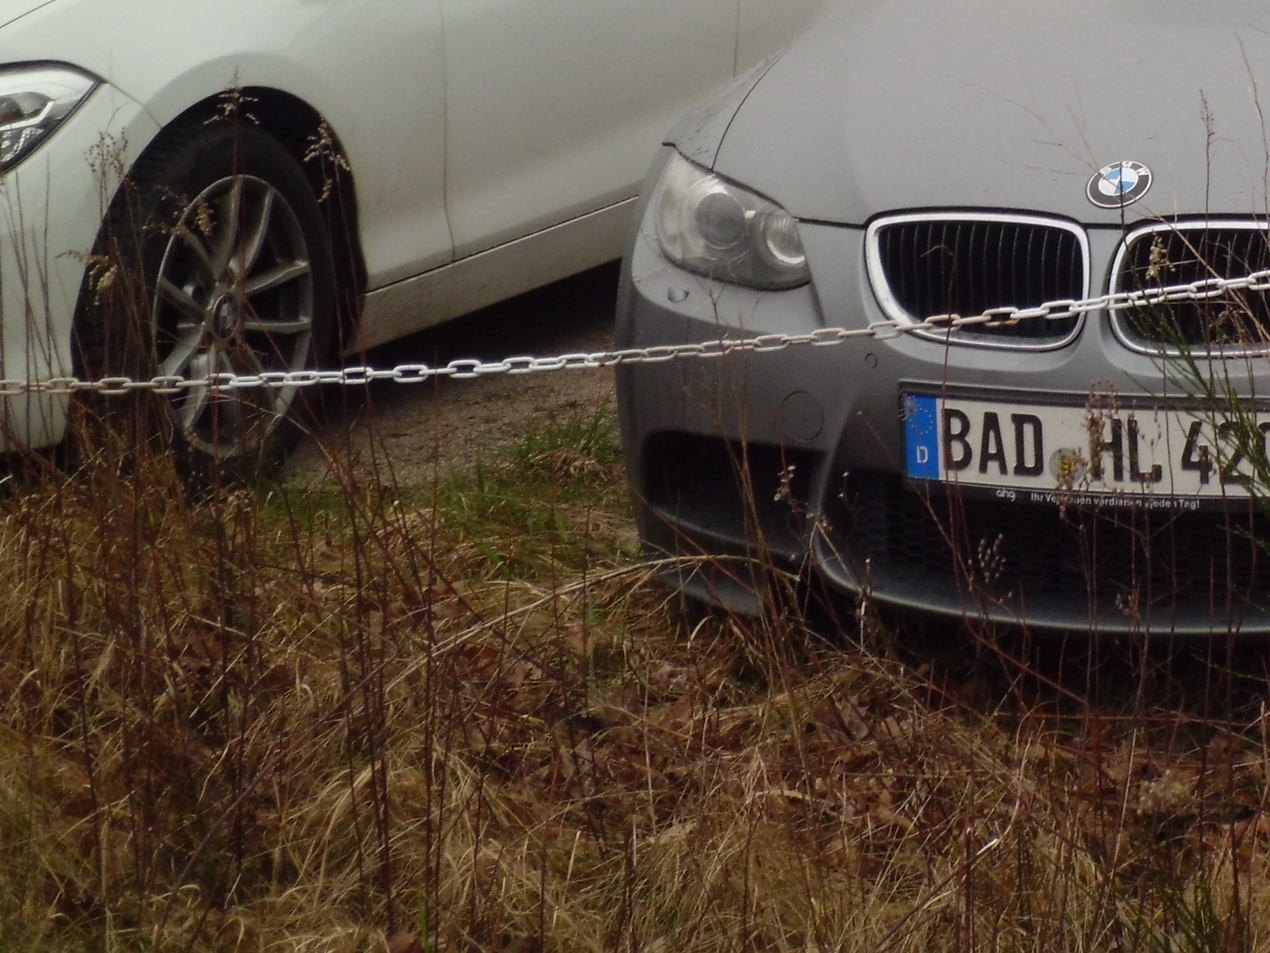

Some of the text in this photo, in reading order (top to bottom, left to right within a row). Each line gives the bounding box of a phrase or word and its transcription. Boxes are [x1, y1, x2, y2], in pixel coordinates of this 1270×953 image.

[1099, 160, 1150, 176] BMW
[942, 408, 1044, 476] BAD
[1089, 417, 1162, 482] HL
[916, 446, 929, 464] D
[1030, 492, 1044, 502] Ihr
